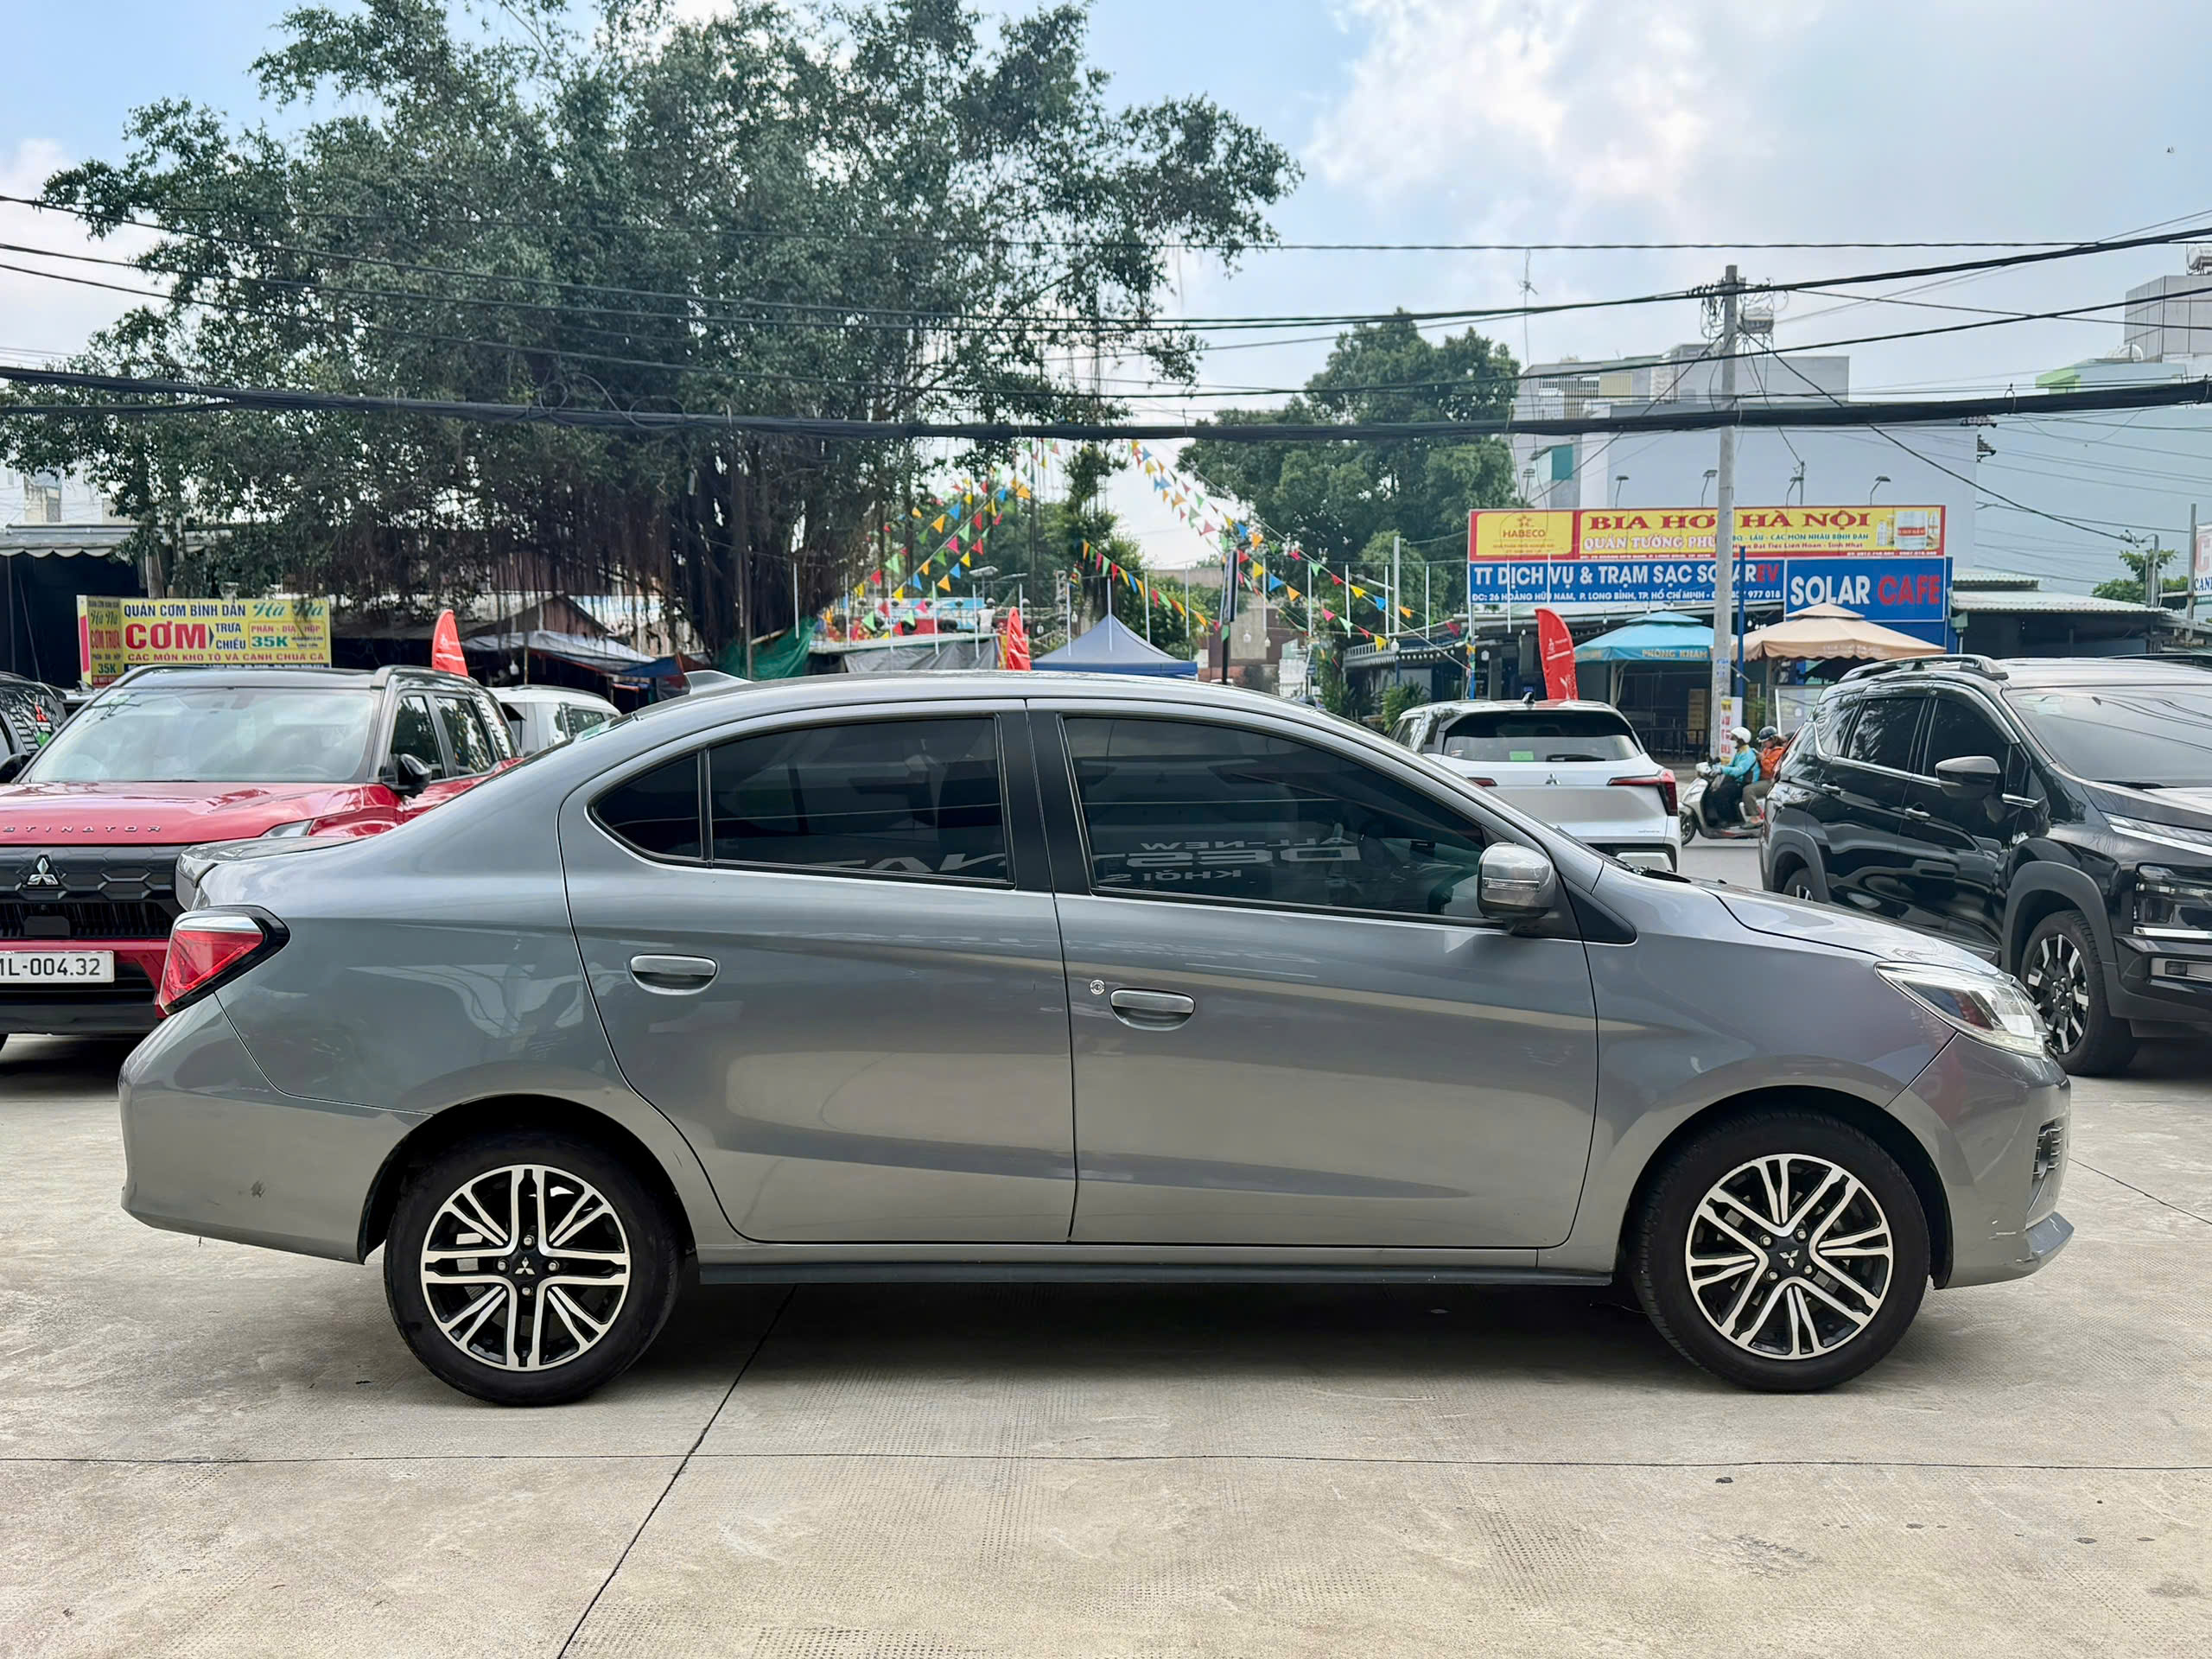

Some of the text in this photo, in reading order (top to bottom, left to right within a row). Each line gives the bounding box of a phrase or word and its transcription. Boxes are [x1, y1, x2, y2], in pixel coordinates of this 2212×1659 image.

[1589, 509, 1872, 530] BIA HƠ HÀ NỘI
[1503, 529, 1547, 539] HABECO
[1473, 567, 1493, 586] TT
[1497, 566, 1544, 589] DỊCH
[1550, 566, 1575, 589] VỤ
[1580, 566, 1593, 585] &
[1598, 565, 1648, 588] TRẠM
[1653, 564, 1694, 588] SẠC
[1489, 593, 1500, 601] 26
[1501, 590, 1533, 601] HOÀNG
[1588, 592, 1612, 601] LONG
[1651, 588, 1665, 600] HỒ
[1666, 588, 1681, 600] CHÍ
[1682, 591, 1704, 600] MINH
[1790, 575, 1941, 607] SOLAR CAFE
[124, 602, 156, 618] QUÁN
[160, 604, 186, 617] CƠM
[190, 601, 218, 617] BÌNH
[215, 622, 242, 633] TRƯA
[125, 620, 207, 650] CƠM
[251, 636, 288, 648] 35K
[182, 653, 204, 662] KHO
[276, 653, 306, 662] CHUA
[98, 664, 117, 674] 35K
